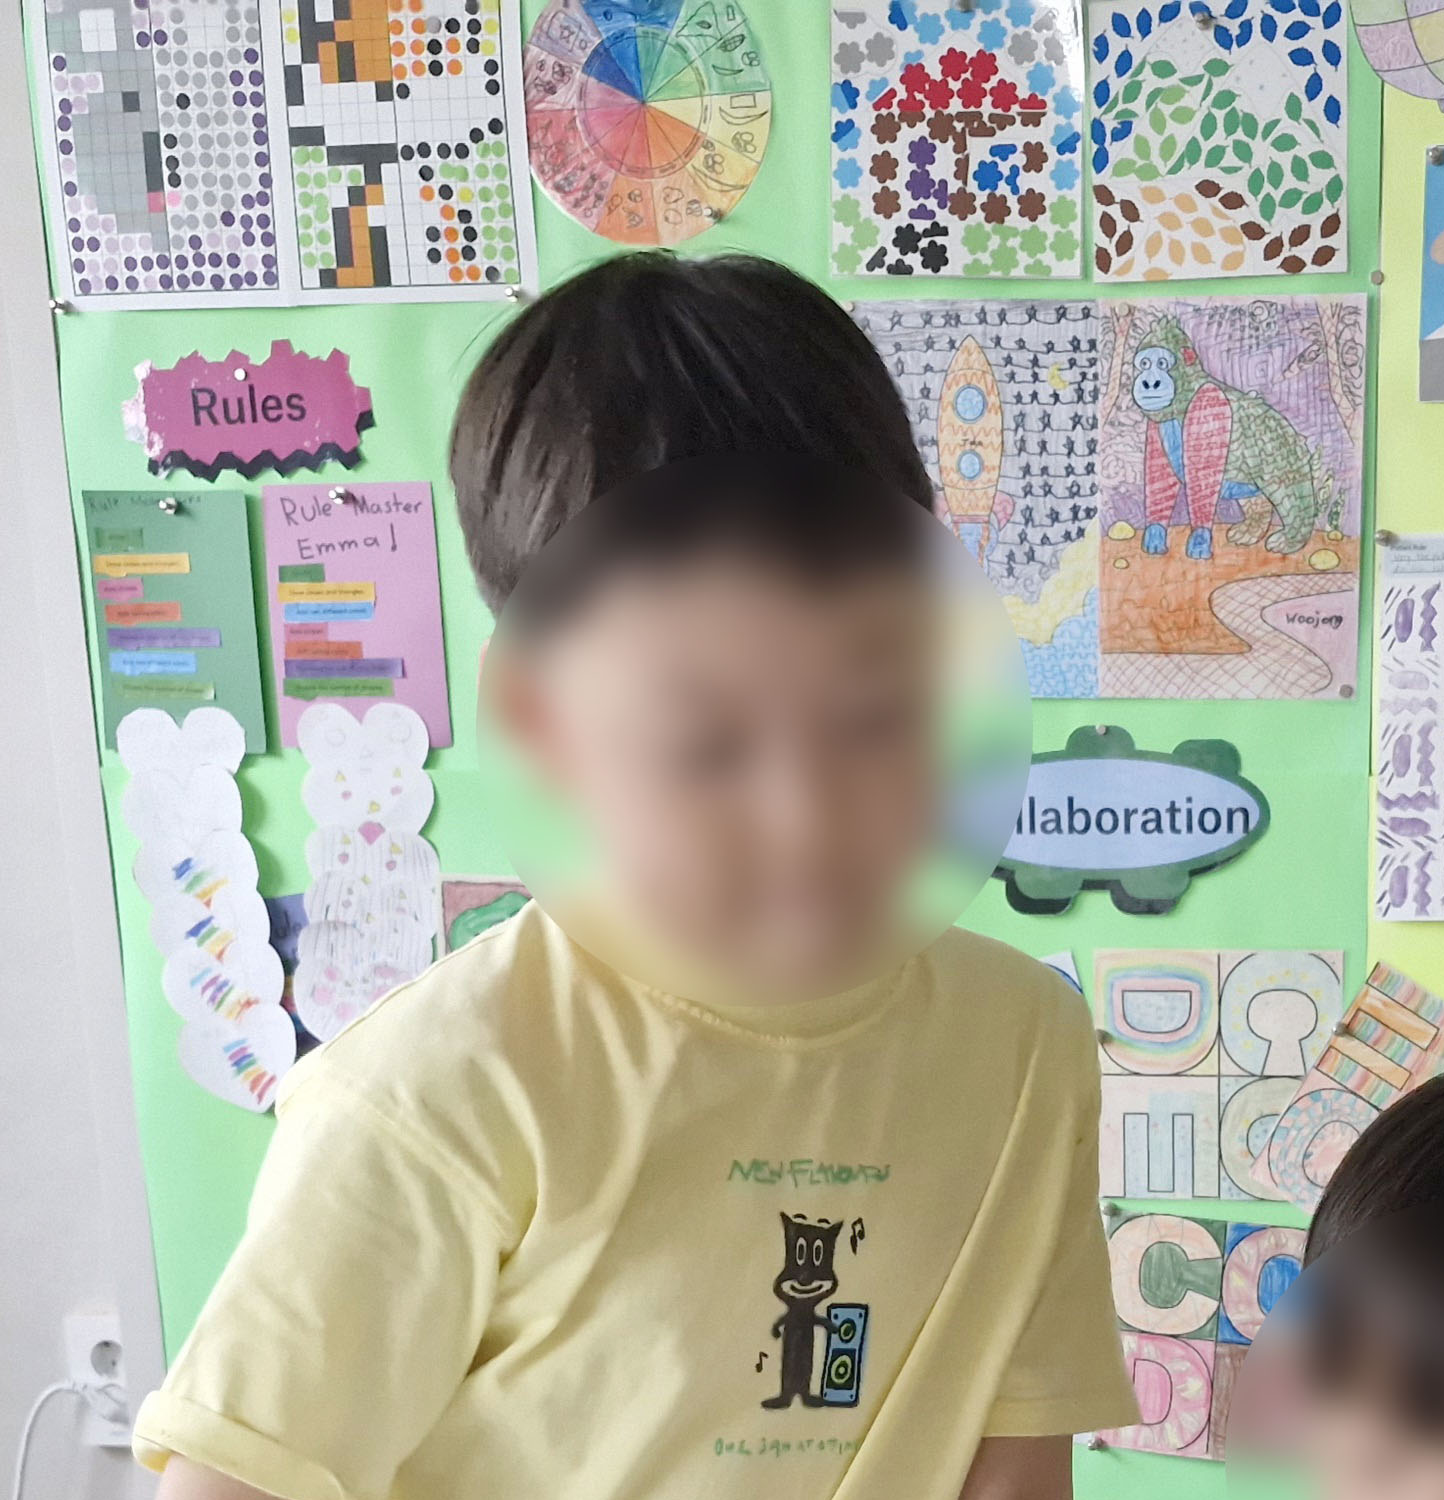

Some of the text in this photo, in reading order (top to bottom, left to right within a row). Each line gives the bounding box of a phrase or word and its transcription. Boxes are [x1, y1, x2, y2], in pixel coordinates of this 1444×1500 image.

[190, 386, 308, 427] Rules
[282, 493, 423, 526] Rule Master
